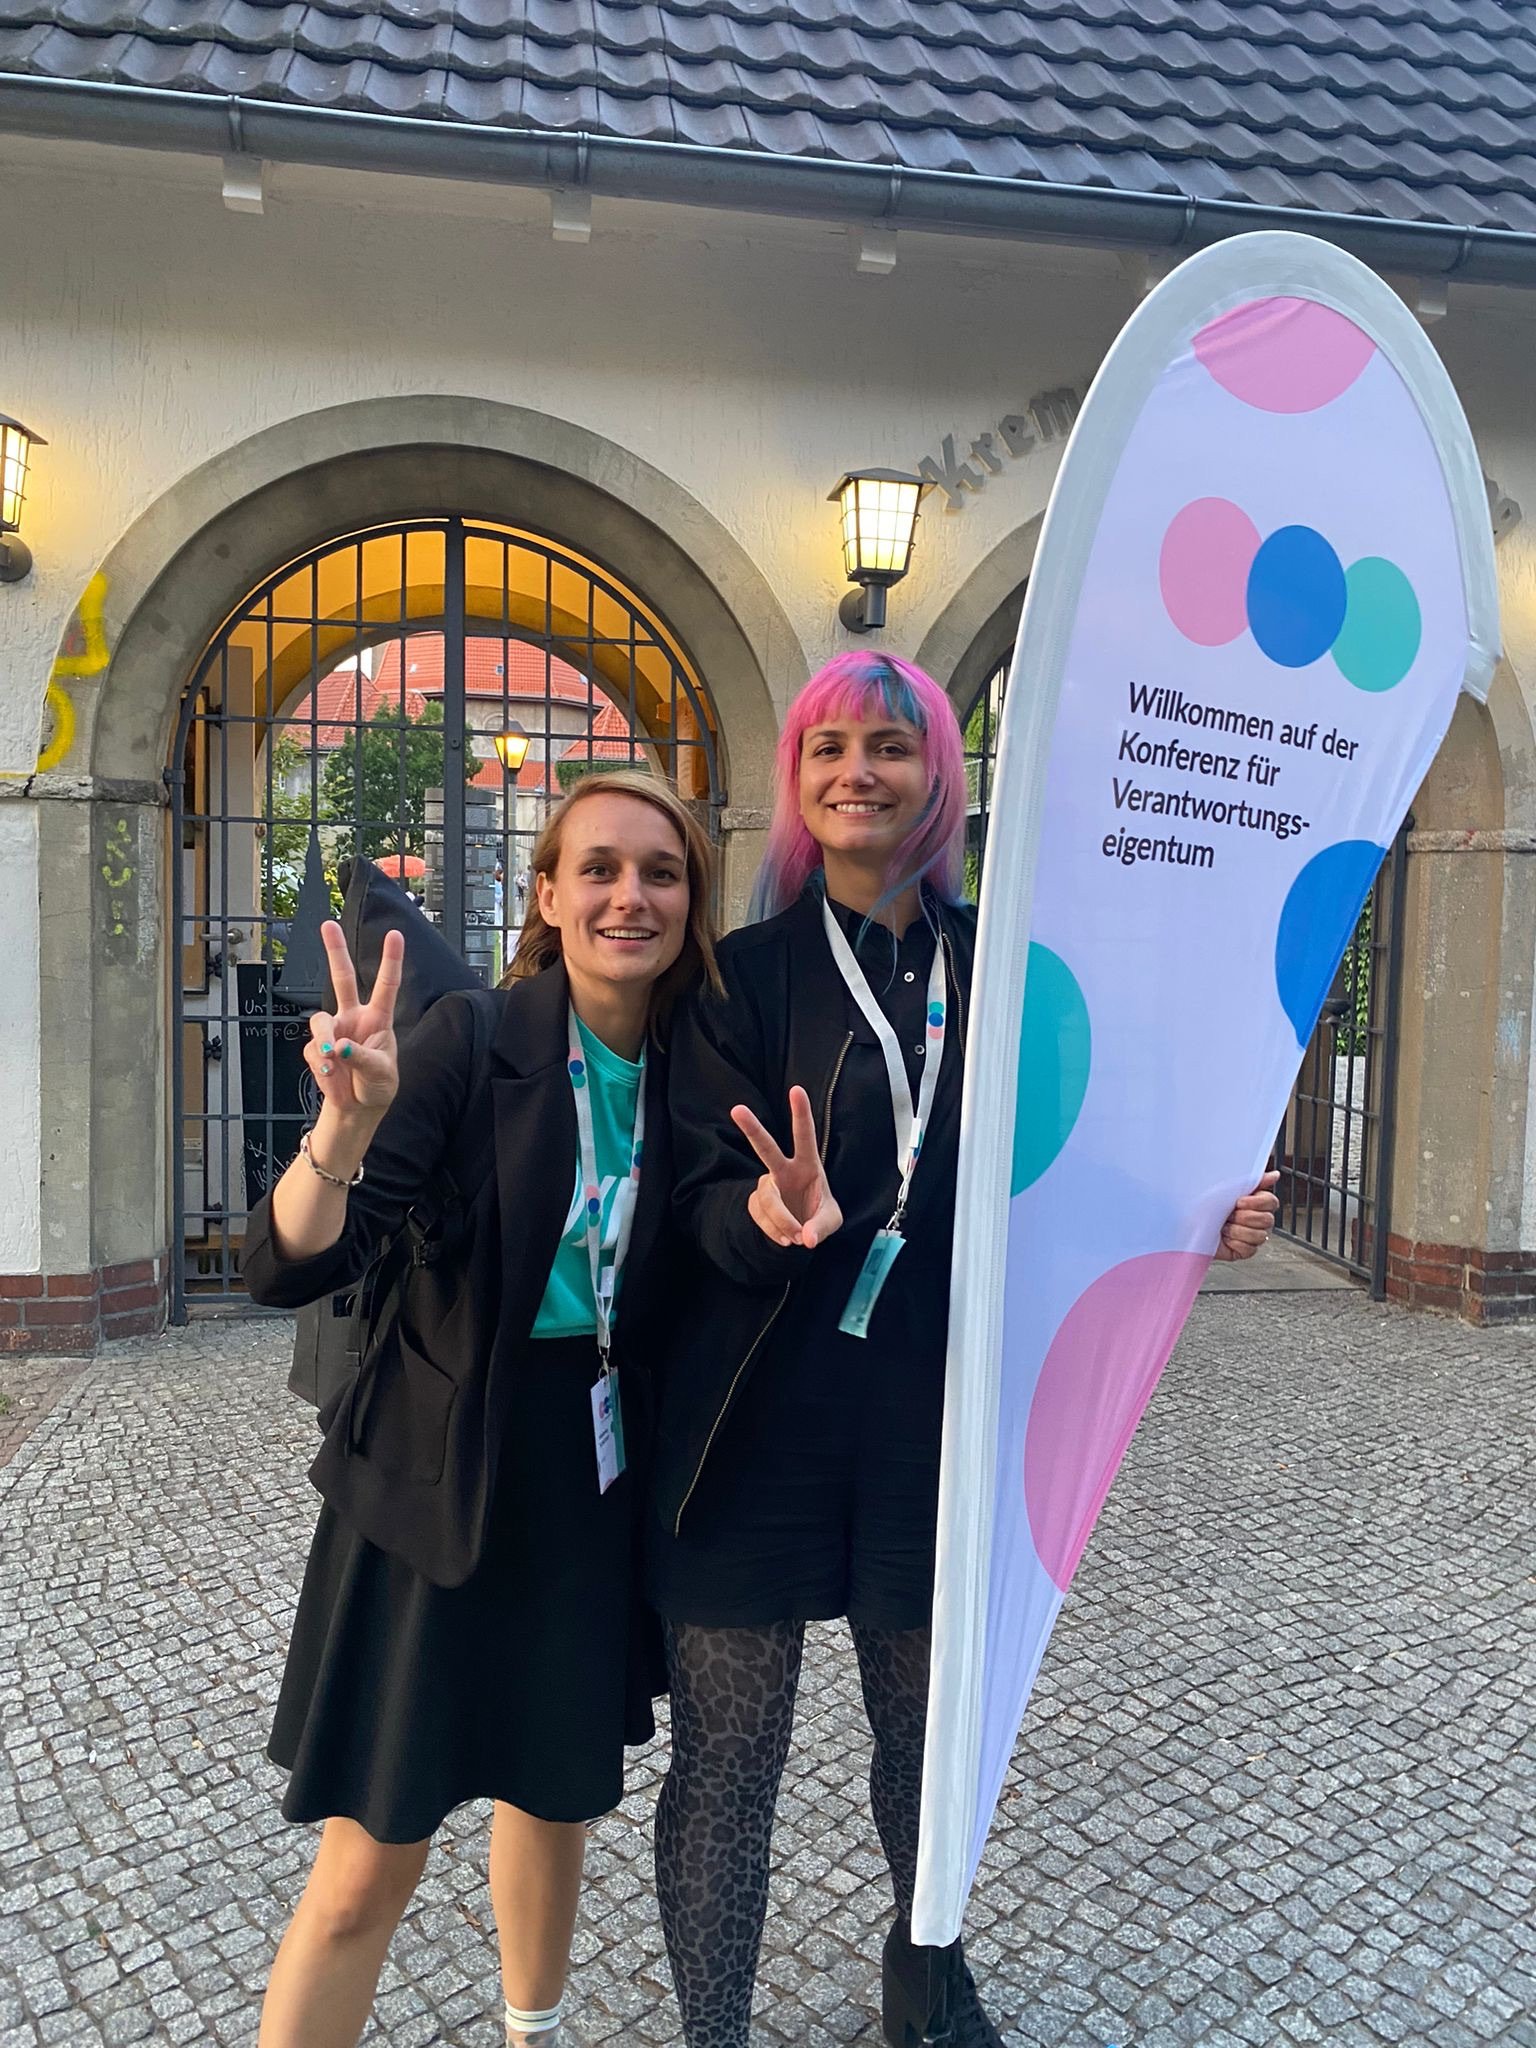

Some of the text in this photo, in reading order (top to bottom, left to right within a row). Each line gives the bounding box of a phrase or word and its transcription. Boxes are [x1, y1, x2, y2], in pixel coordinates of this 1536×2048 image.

[1129, 682, 1359, 760] Willkommen auf der
[1118, 729, 1281, 787] Konferenz für
[1112, 777, 1310, 840] Verantwortungs-
[1102, 827, 1214, 868] eigentum
